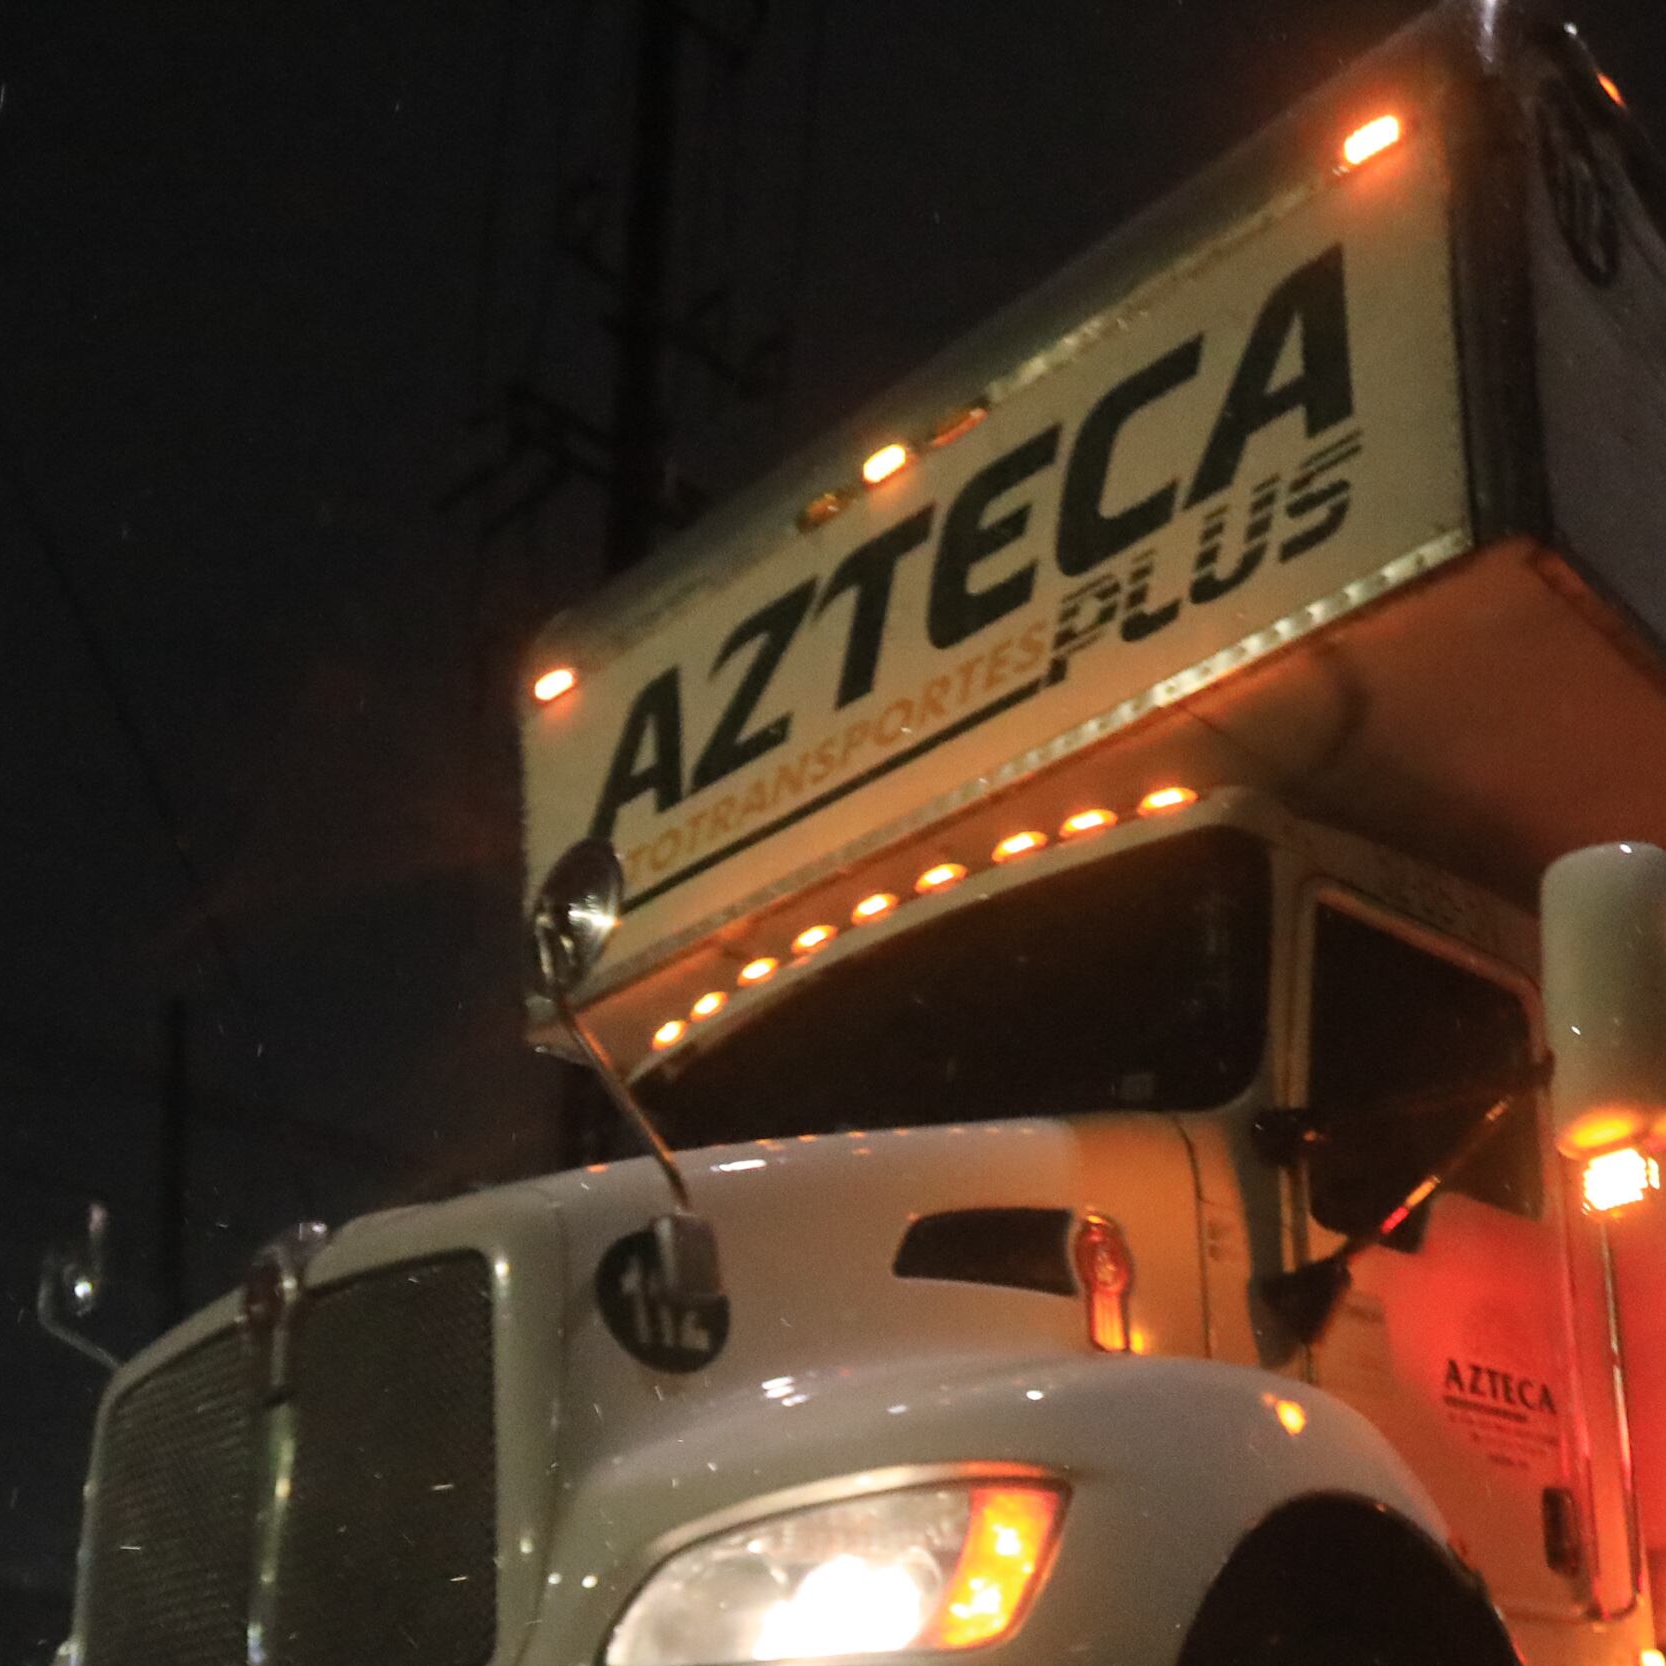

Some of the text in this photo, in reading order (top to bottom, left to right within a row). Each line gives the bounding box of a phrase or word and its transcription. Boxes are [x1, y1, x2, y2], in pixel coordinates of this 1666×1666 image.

[587, 243, 1354, 846] AZTECA
[625, 426, 1364, 882] TOTRANSPORTES PLUS
[1444, 1359, 1556, 1414] AZTECA
